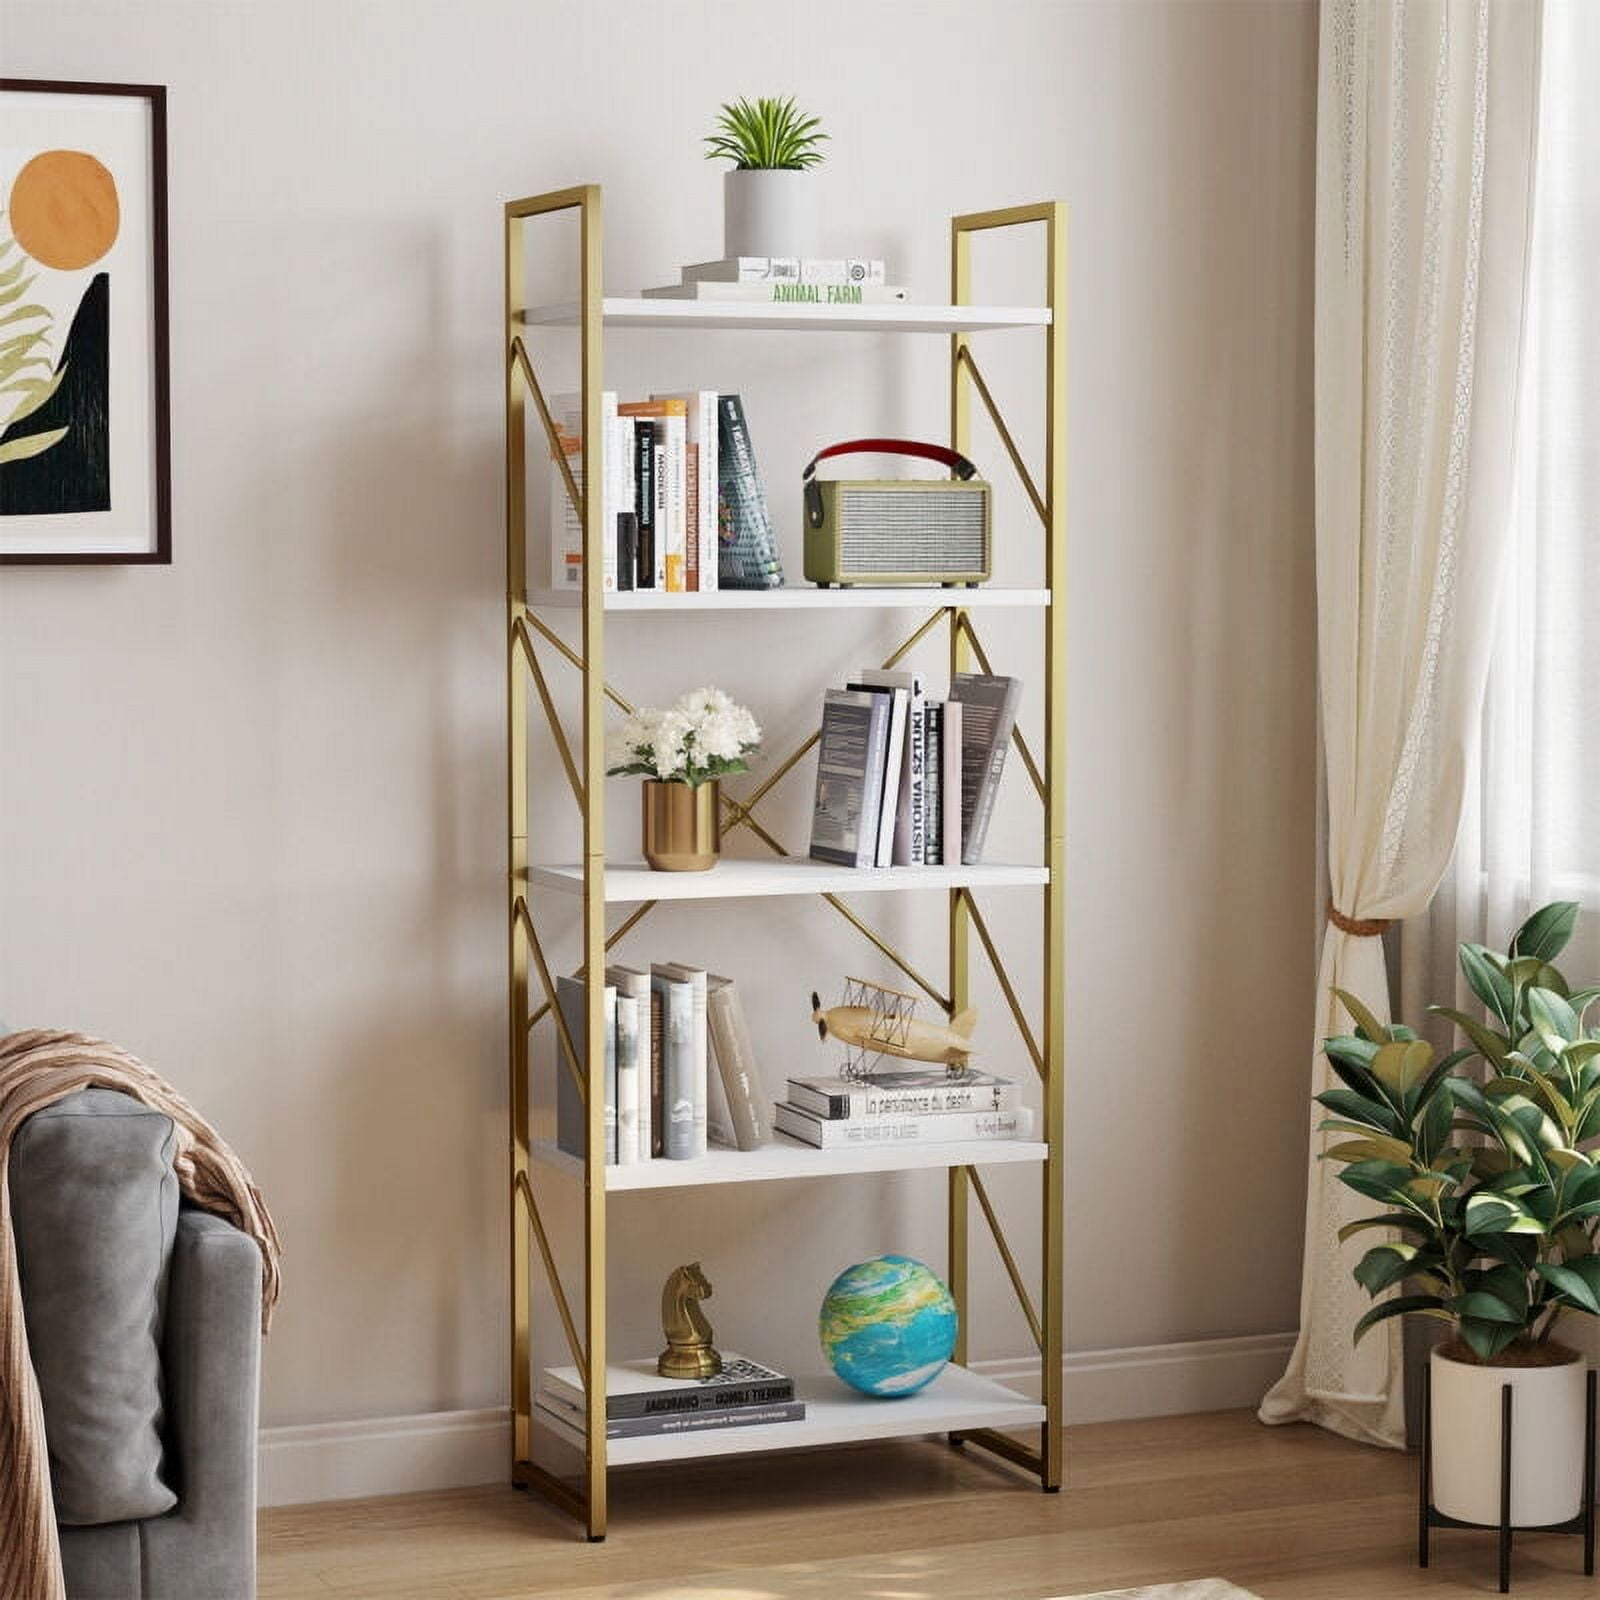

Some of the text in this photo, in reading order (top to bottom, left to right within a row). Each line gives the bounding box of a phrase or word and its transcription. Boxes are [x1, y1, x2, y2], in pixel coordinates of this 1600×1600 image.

[773, 284, 863, 304] ANIMAL FARM
[912, 710, 924, 863] HISTORIA SZTUKI
